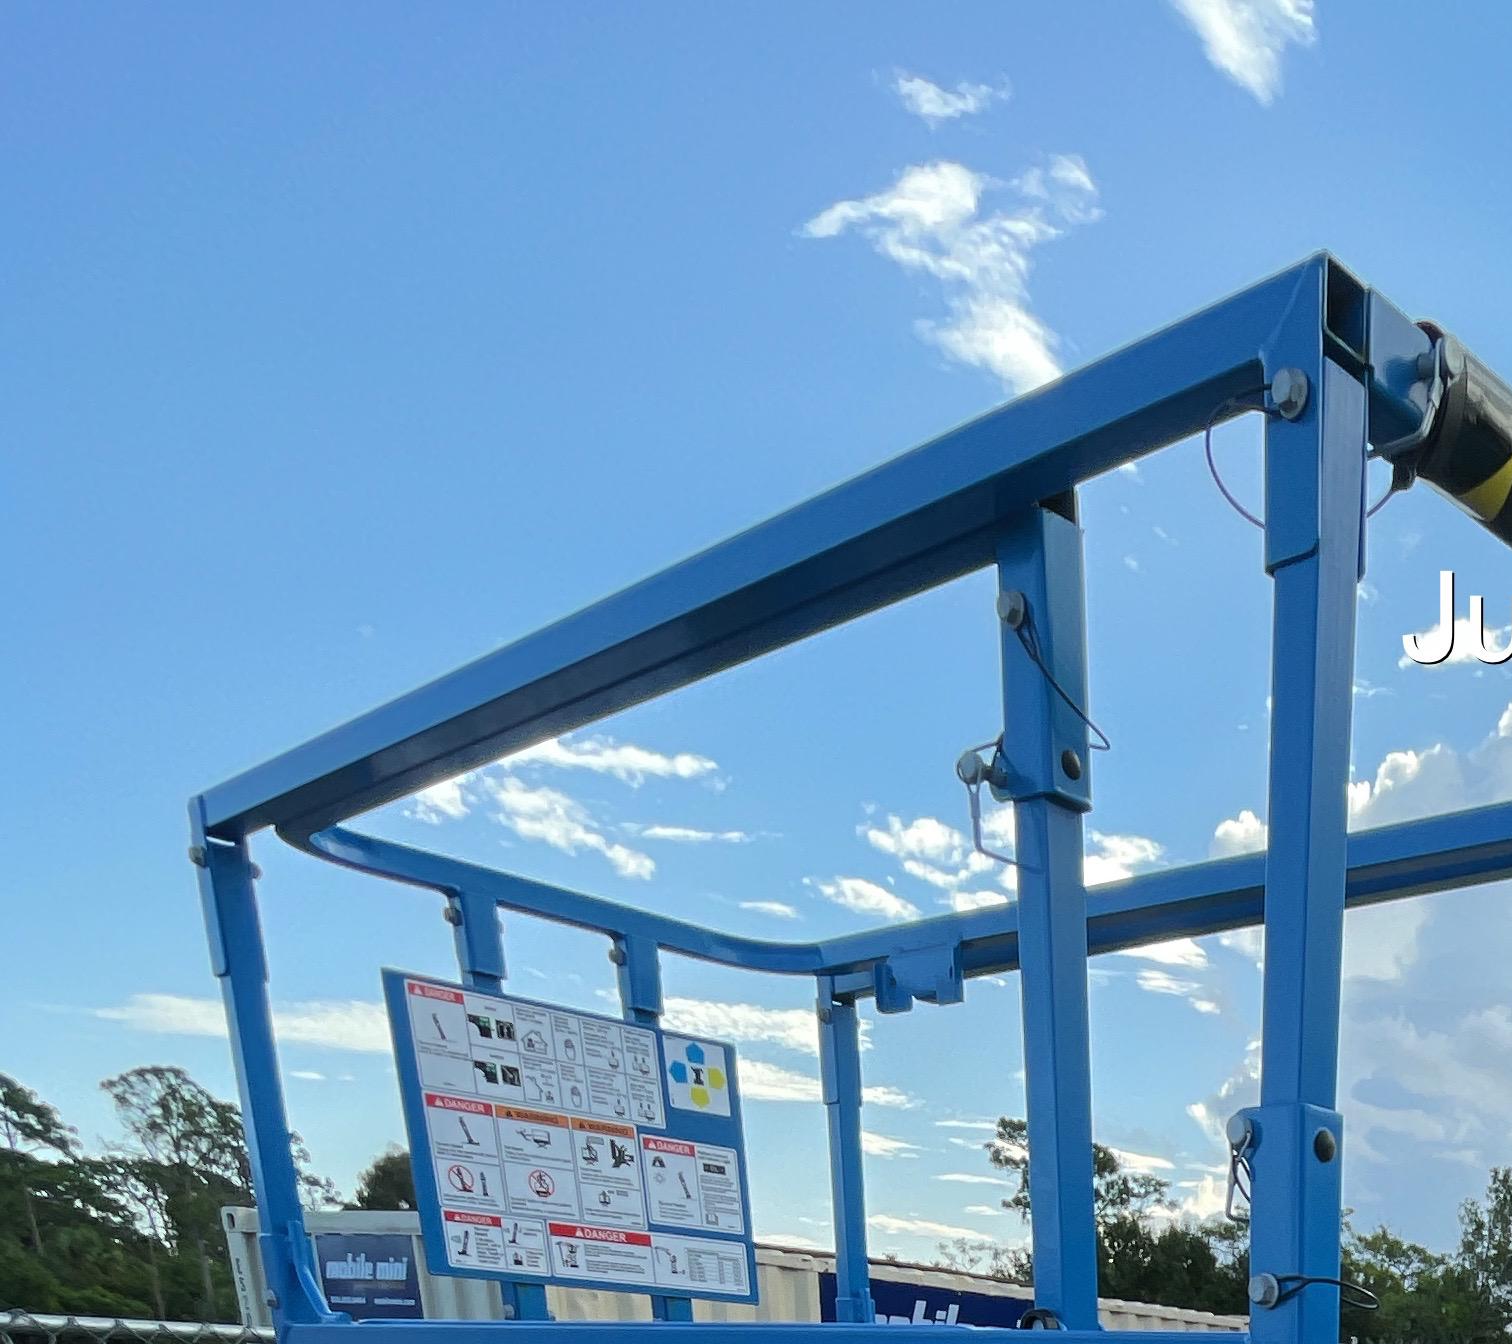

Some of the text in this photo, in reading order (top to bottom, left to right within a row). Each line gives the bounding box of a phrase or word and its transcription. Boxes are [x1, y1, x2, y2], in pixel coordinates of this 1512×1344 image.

[444, 1096, 485, 1114] DANGER
[655, 1140, 690, 1155] DANGER
[583, 1227, 628, 1243] DANGER
